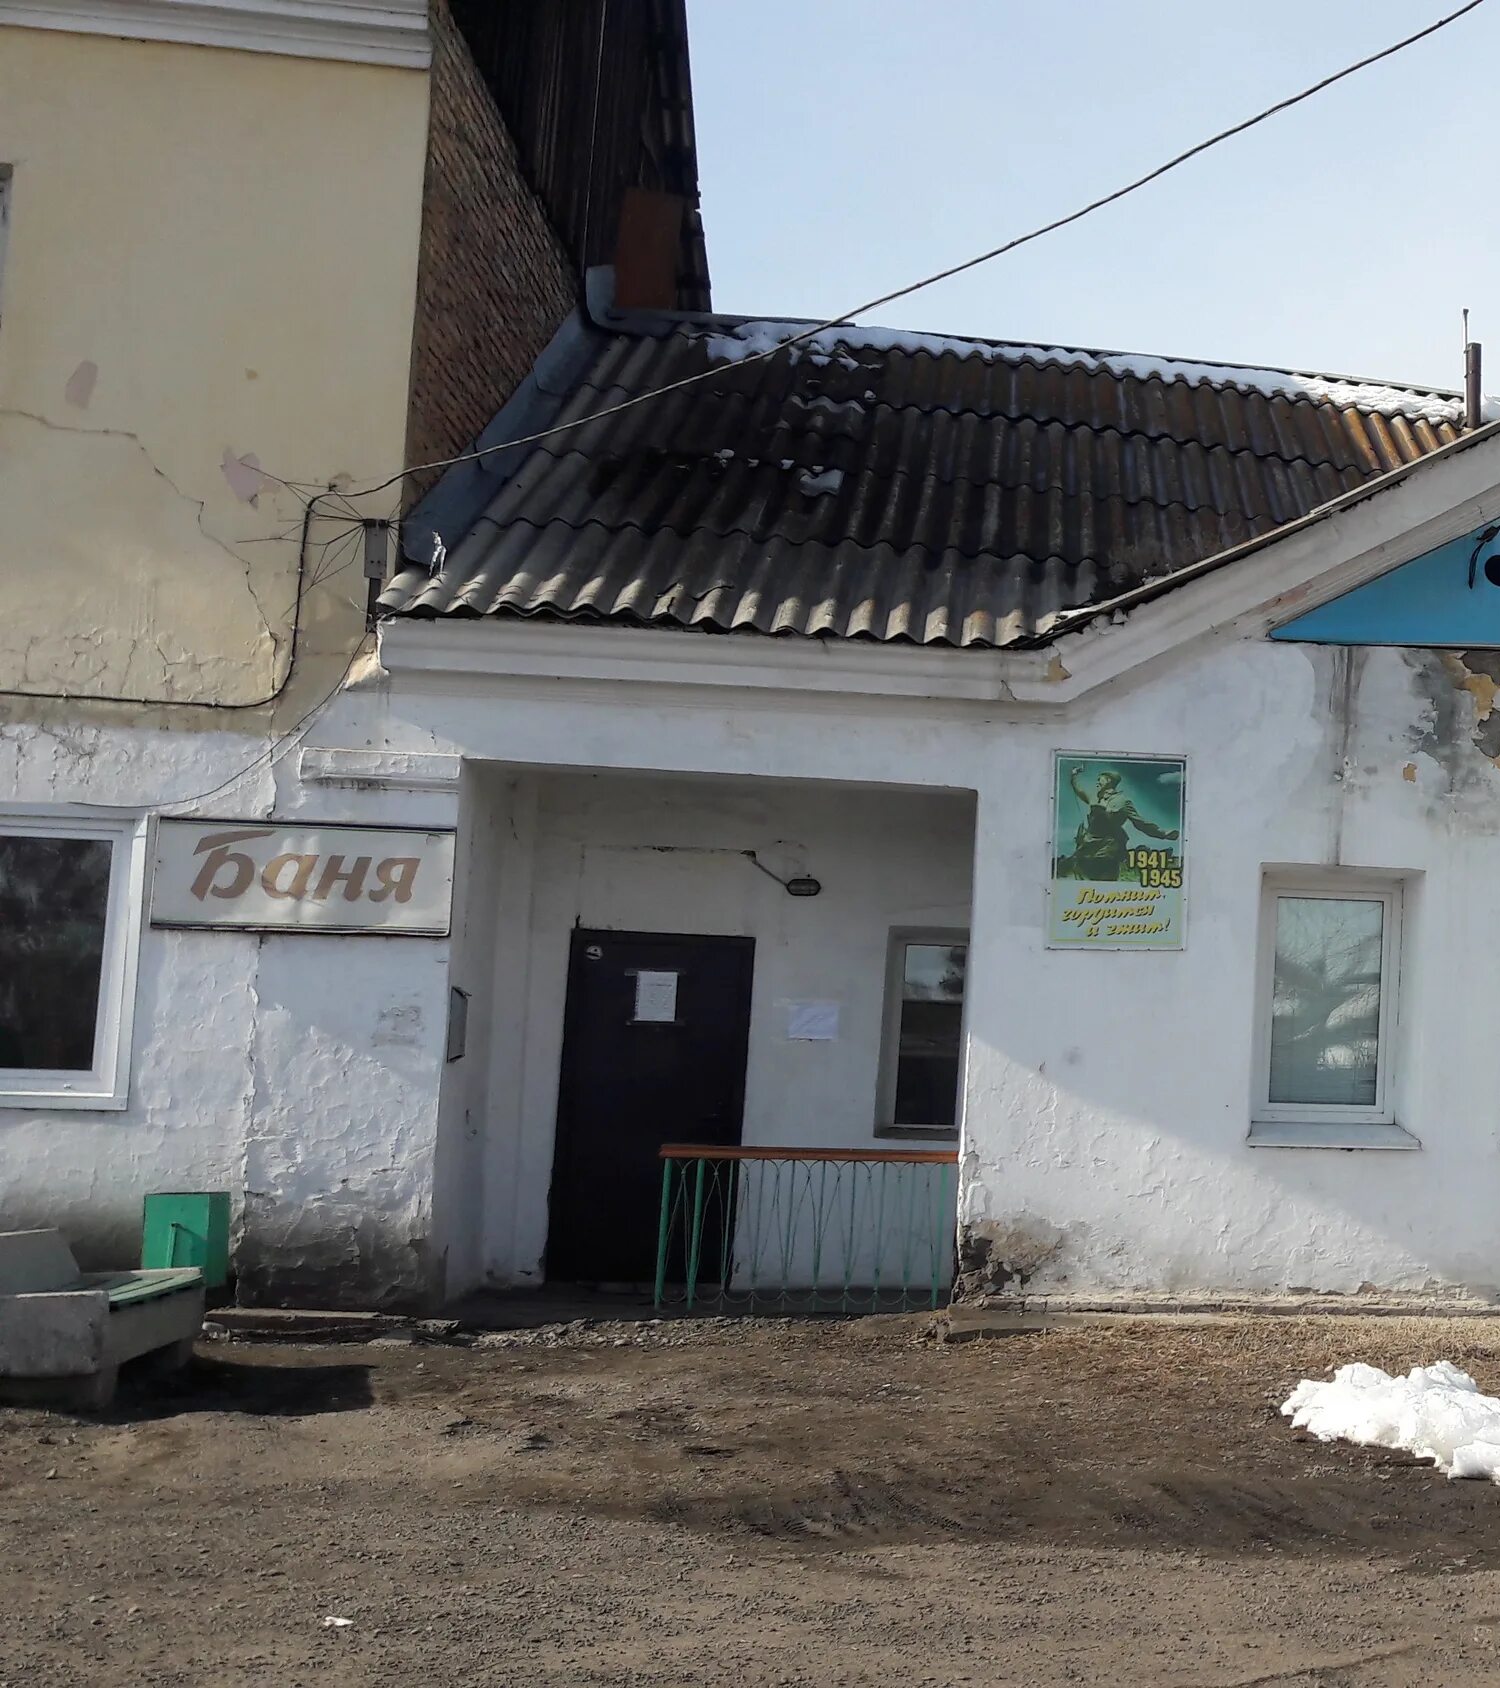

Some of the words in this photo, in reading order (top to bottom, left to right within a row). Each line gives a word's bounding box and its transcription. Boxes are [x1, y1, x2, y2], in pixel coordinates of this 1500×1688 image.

[190, 829, 421, 904] Баня
[1128, 849, 1173, 869] 1941-
[1140, 868, 1182, 888] 1945
